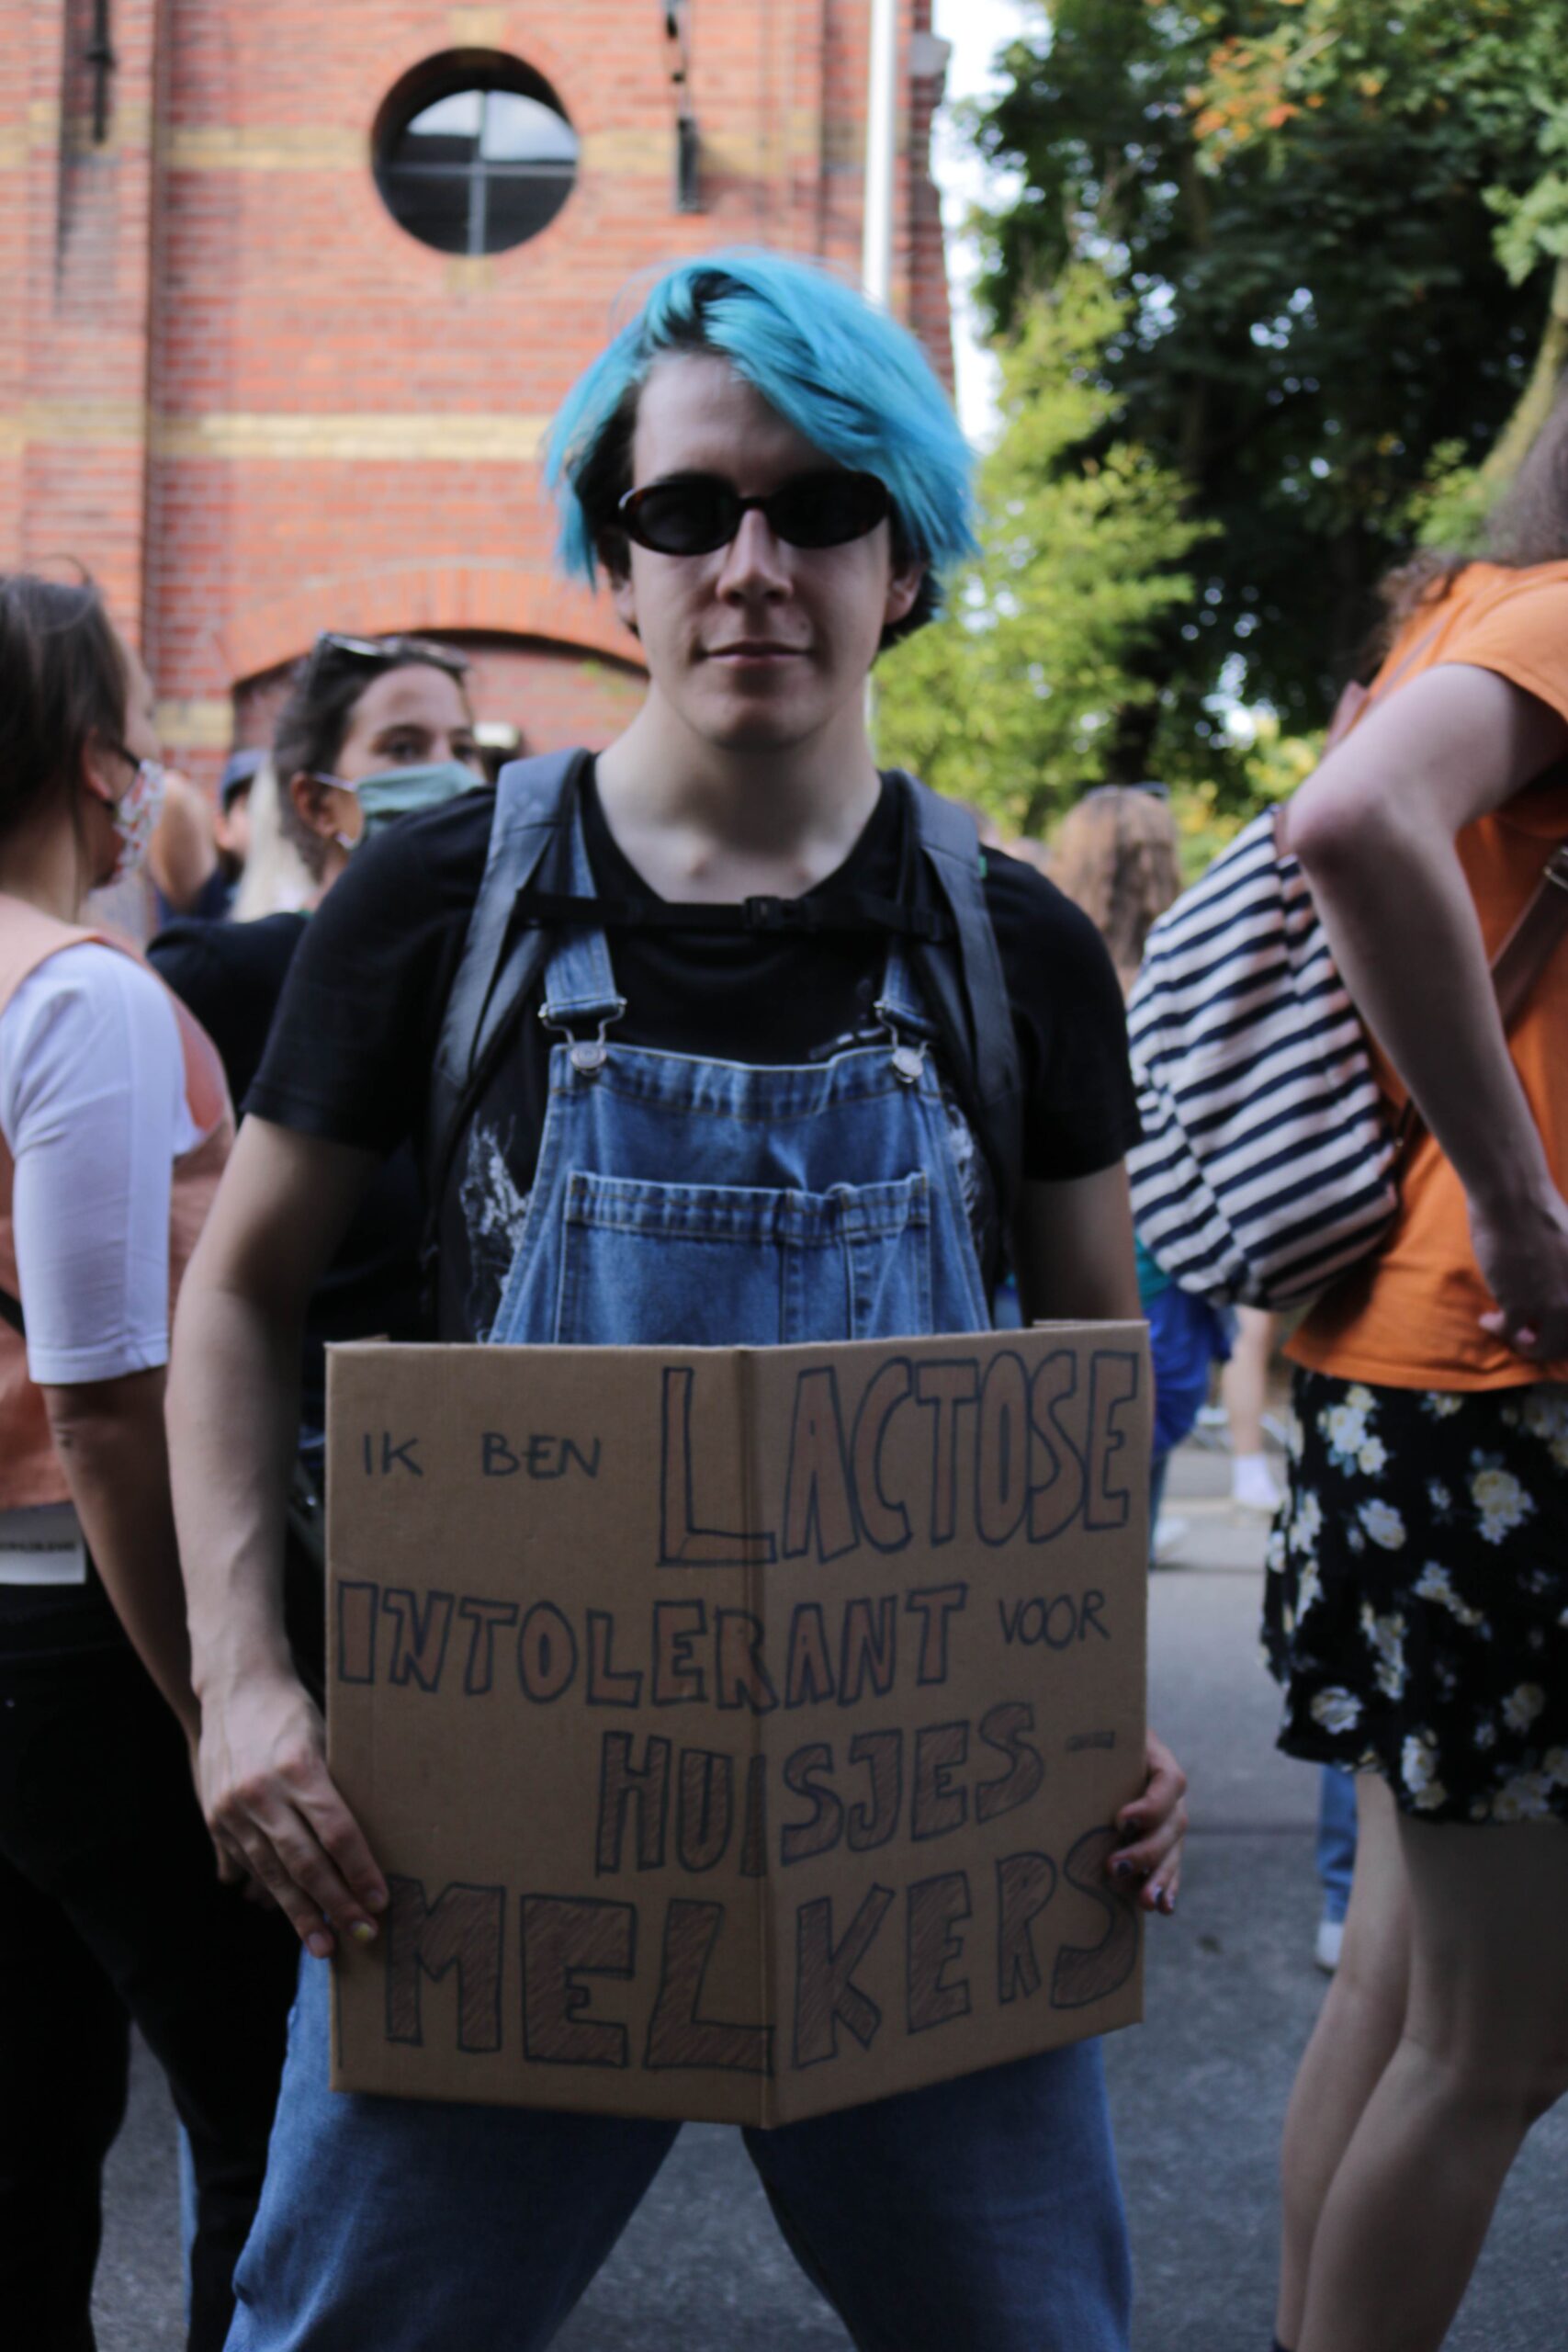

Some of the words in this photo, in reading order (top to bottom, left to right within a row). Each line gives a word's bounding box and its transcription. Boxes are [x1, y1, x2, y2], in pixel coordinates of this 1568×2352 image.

[364, 1432, 423, 1476] IK
[481, 1431, 601, 1479] BEN
[657, 1350, 1139, 1567] LACTOSE
[337, 1580, 968, 1715] INTOLERANT
[998, 1590, 1110, 1650] VOOR
[385, 1826, 1138, 2078] MELKERS
